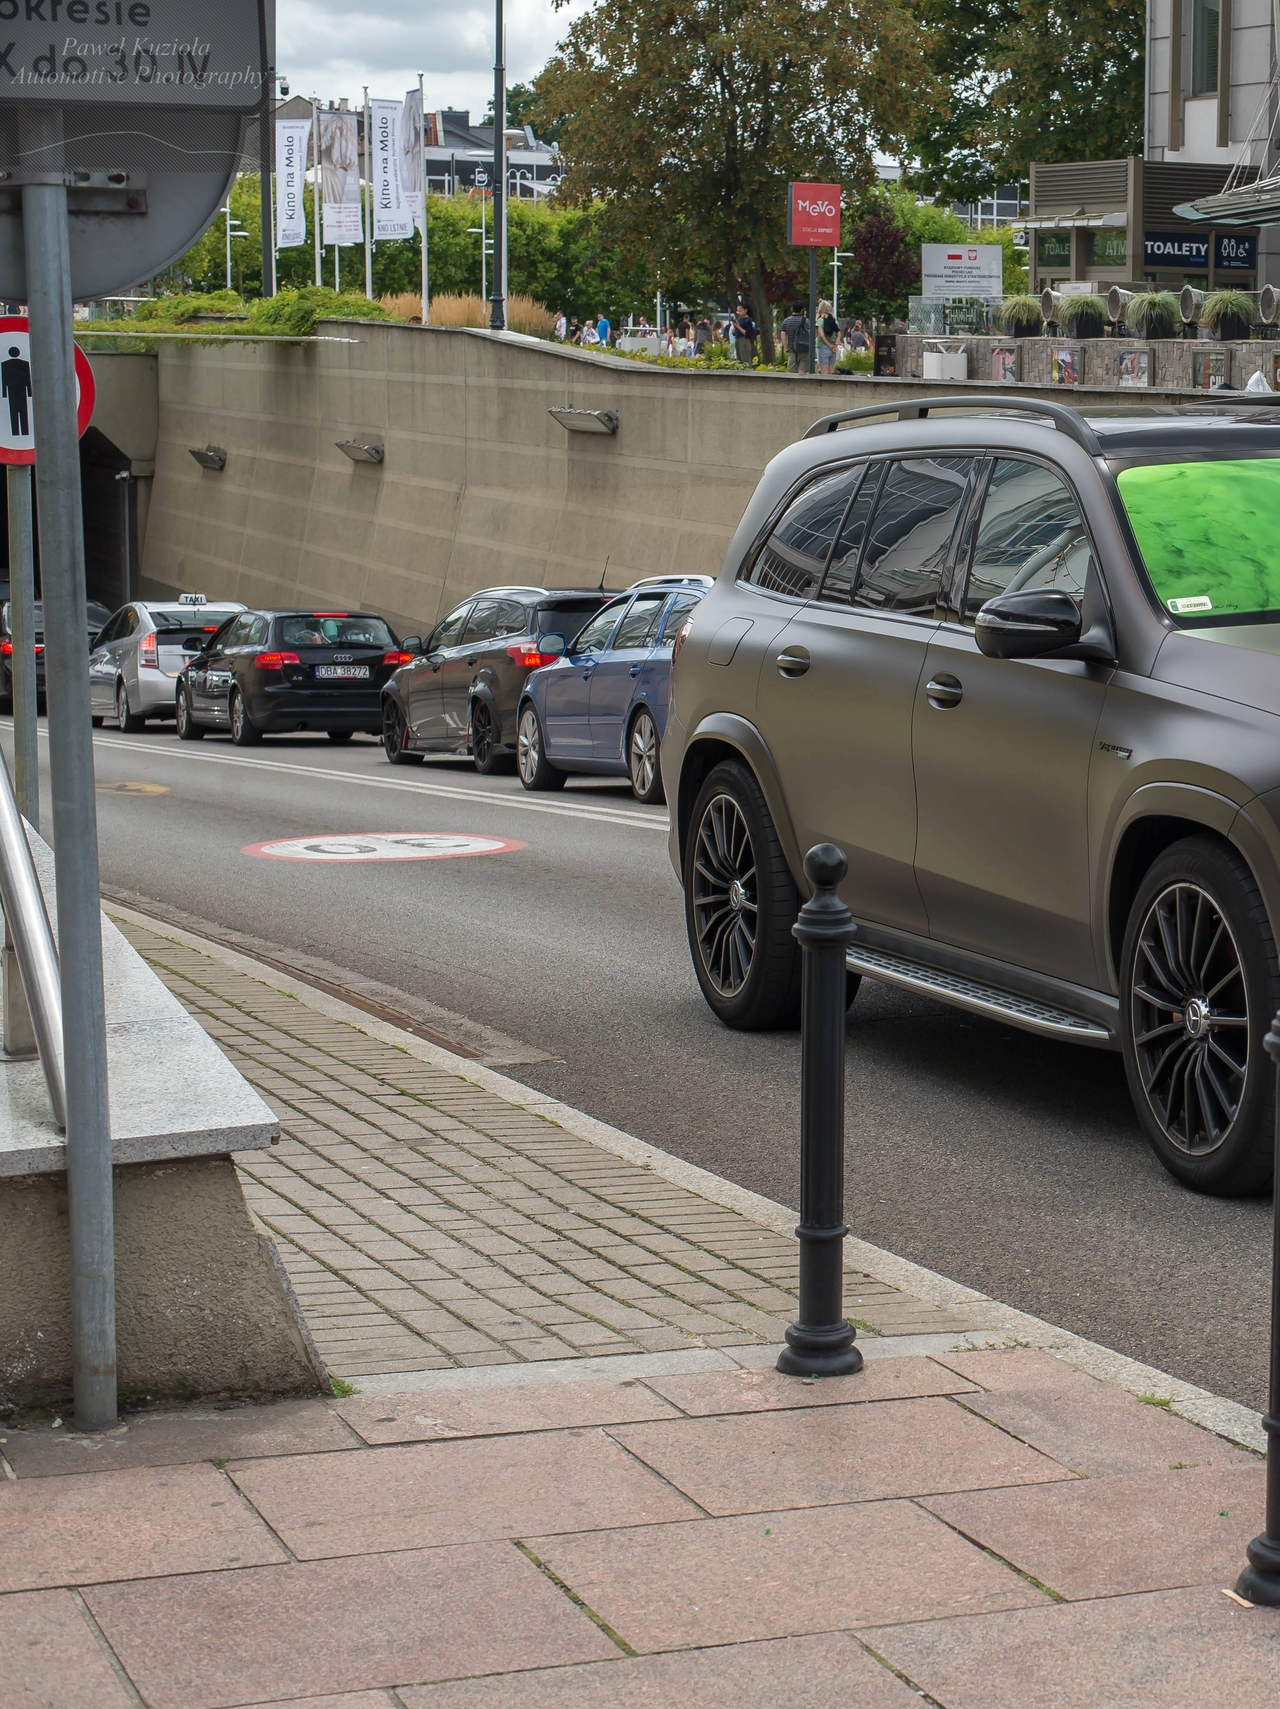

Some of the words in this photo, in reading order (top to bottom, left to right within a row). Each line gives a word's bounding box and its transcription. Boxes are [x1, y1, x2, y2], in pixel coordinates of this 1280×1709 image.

[32, 44, 87, 80] do
[104, 46, 211, 84] 30.IV
[379, 116, 389, 152] Molo
[284, 135, 295, 168] Molo
[380, 157, 389, 174] na
[286, 172, 295, 188] na
[380, 179, 392, 210] Kino
[285, 192, 296, 220] Kino
[1044, 242, 1071, 256] TOALE
[1105, 239, 1127, 256] ATM
[1144, 241, 1209, 256] TOALETY
[184, 596, 203, 604] TAXI
